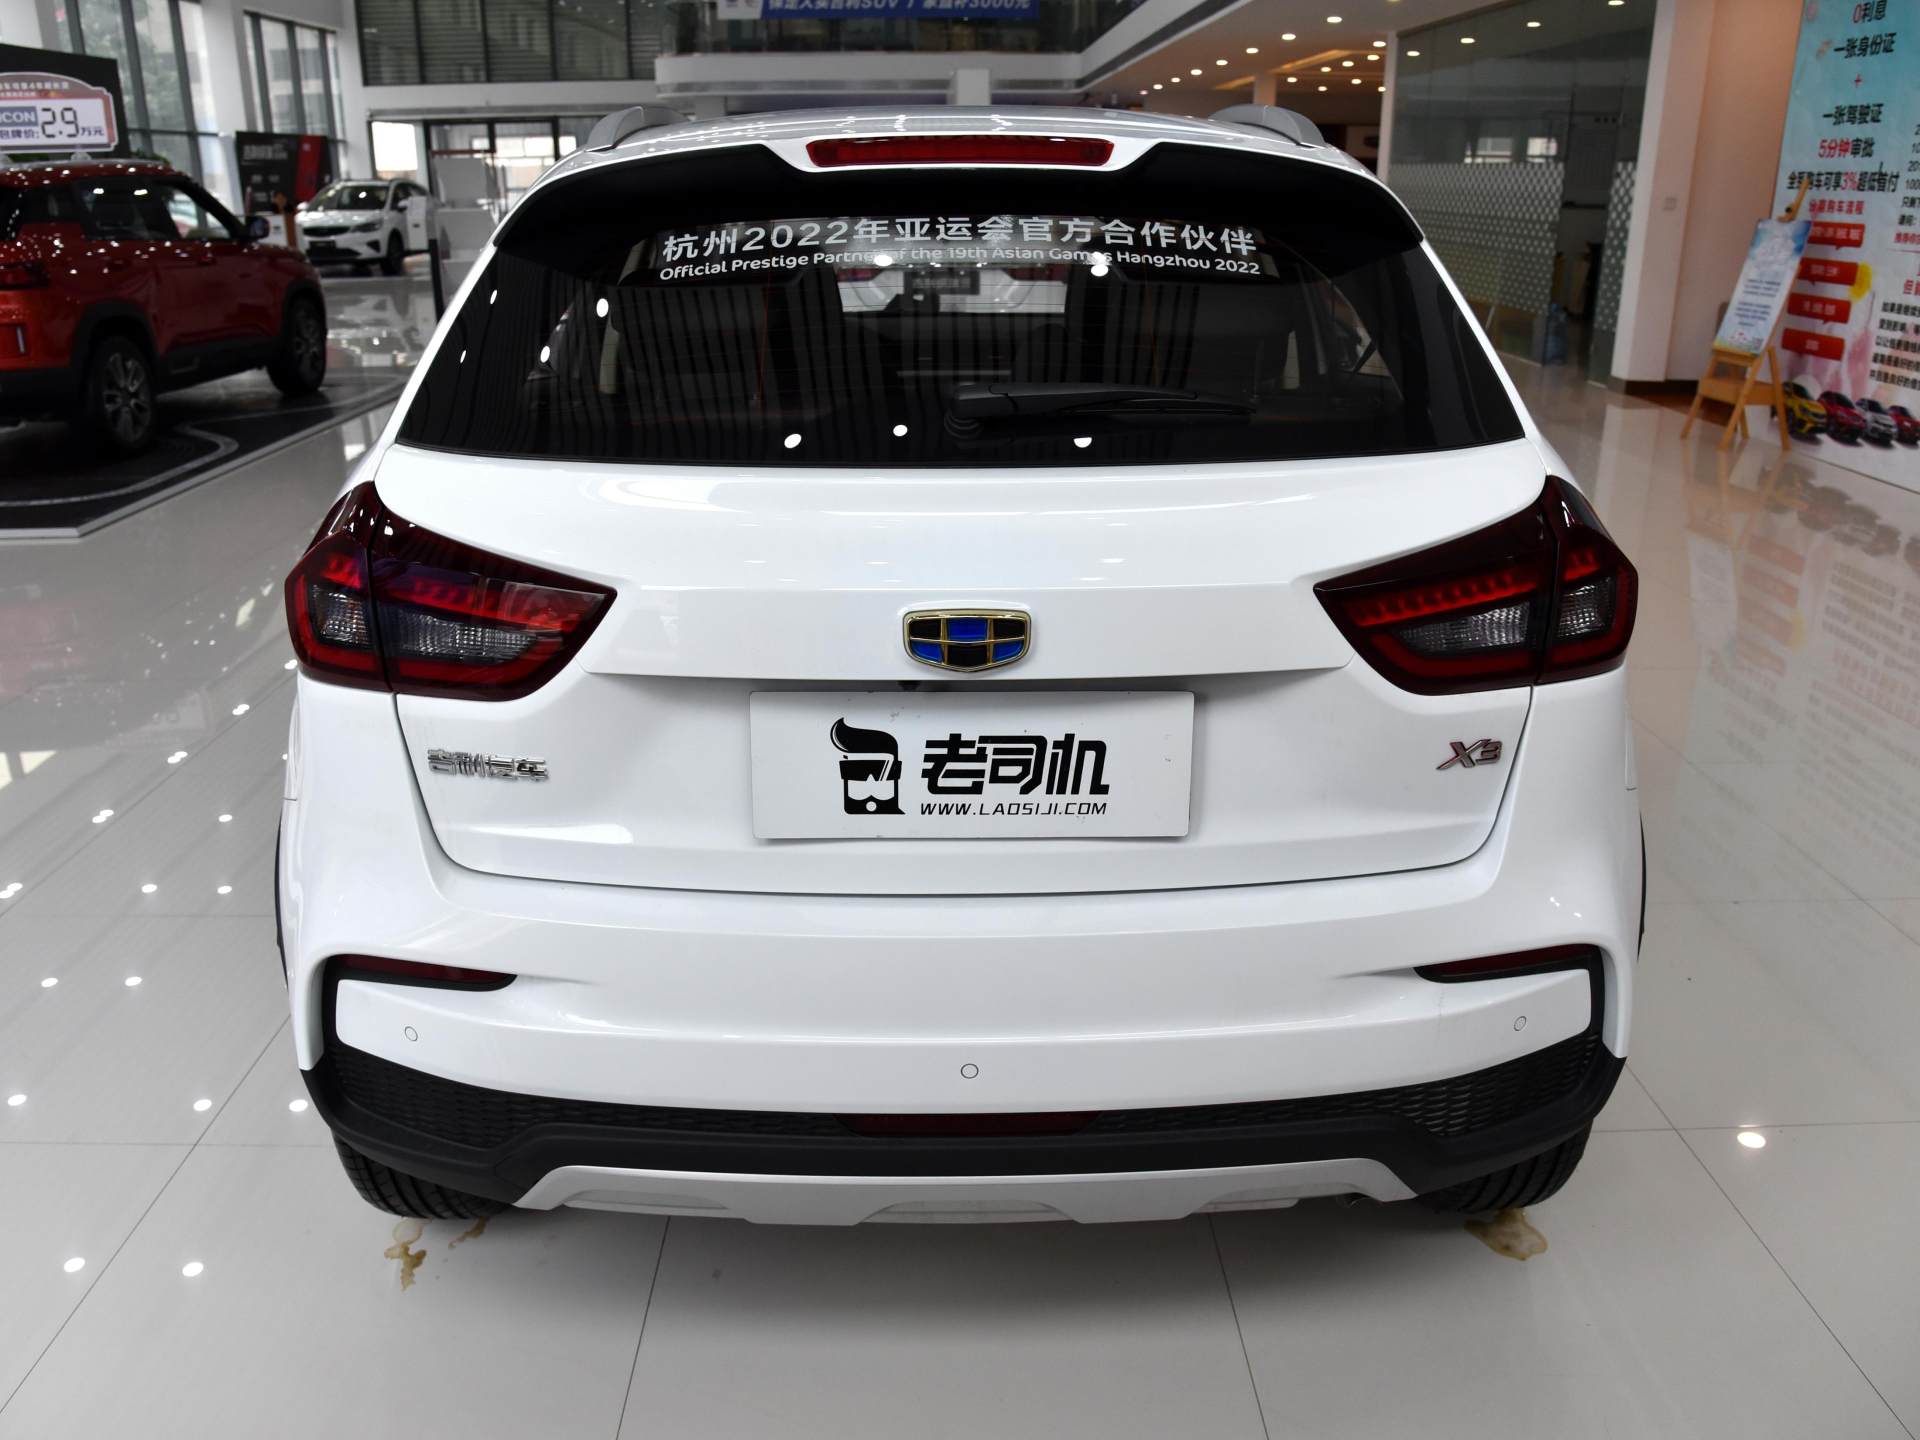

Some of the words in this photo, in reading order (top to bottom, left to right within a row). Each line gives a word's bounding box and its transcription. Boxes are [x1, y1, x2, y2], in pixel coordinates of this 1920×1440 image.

[1834, 32, 1897, 59] 一张身份证
[41, 107, 79, 138] 2.9
[1822, 103, 1884, 126] 一张驾驶证
[1818, 137, 1875, 158] 5分钟审批
[662, 216, 1257, 263] 杭州2022年亚运会官方合作伙伴
[659, 260, 728, 281] Official
[731, 254, 809, 272] Prestige
[911, 248, 943, 260] the
[949, 247, 988, 260] 19th
[992, 248, 1044, 260] Asian
[1116, 250, 1211, 270] Hangzhou
[1214, 258, 1261, 275] 2022
[921, 733, 1110, 795] 老司机
[1436, 738, 1503, 770] X3
[920, 802, 1107, 816] WWW.LAOSIJI.COM
